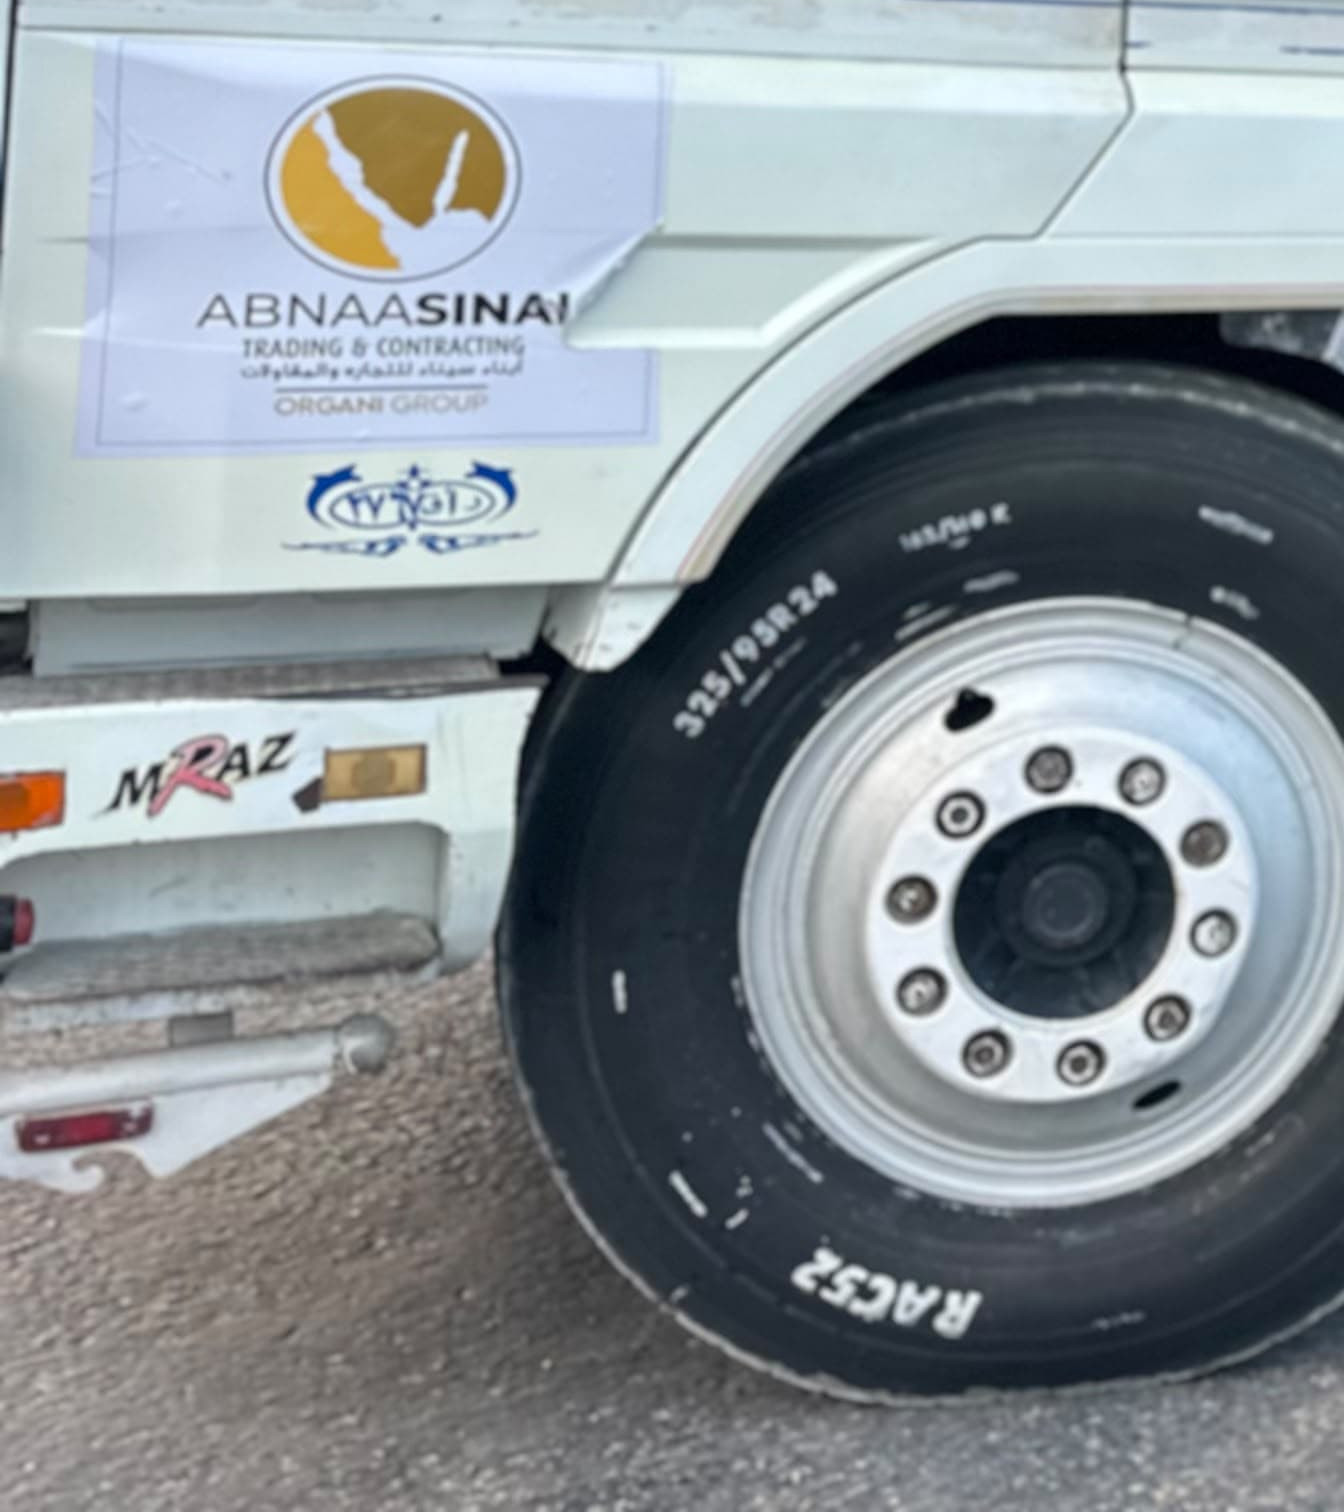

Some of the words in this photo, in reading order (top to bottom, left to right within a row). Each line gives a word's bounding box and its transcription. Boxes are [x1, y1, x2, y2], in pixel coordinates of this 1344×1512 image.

[242, 335, 343, 359] TRADING
[351, 338, 368, 358] &
[375, 335, 526, 358] CONTRACTING
[389, 390, 489, 415] GROUP
[789, 1245, 983, 1341] RAC52
